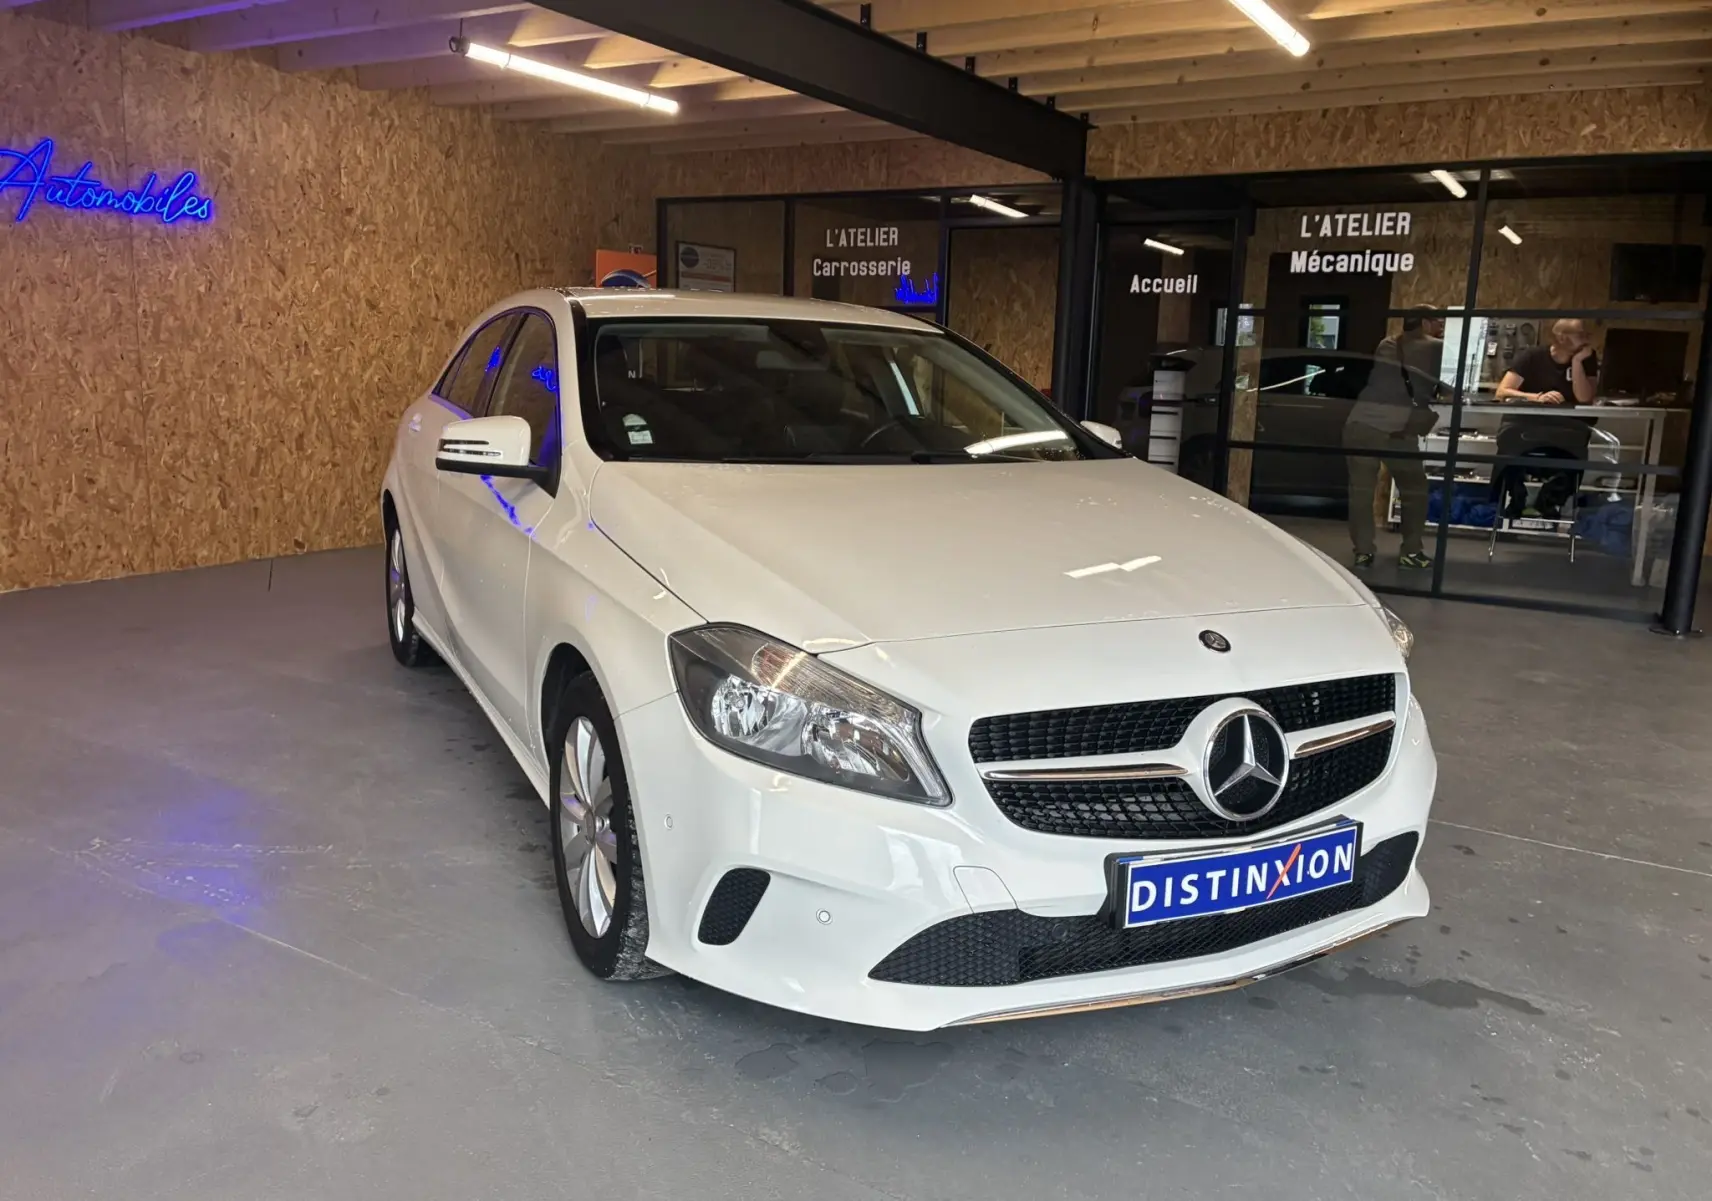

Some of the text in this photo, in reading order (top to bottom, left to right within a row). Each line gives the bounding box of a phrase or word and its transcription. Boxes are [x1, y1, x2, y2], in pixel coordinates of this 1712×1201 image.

[0, 139, 211, 222] Automobiles
[1300, 212, 1411, 237] L'ATELIER
[826, 227, 899, 248] L'ATELIER
[813, 258, 911, 277] Carrosserie
[1290, 250, 1414, 276] Mécanique
[1129, 274, 1198, 294] Accueil
[1131, 843, 1353, 912] DISTINXION
